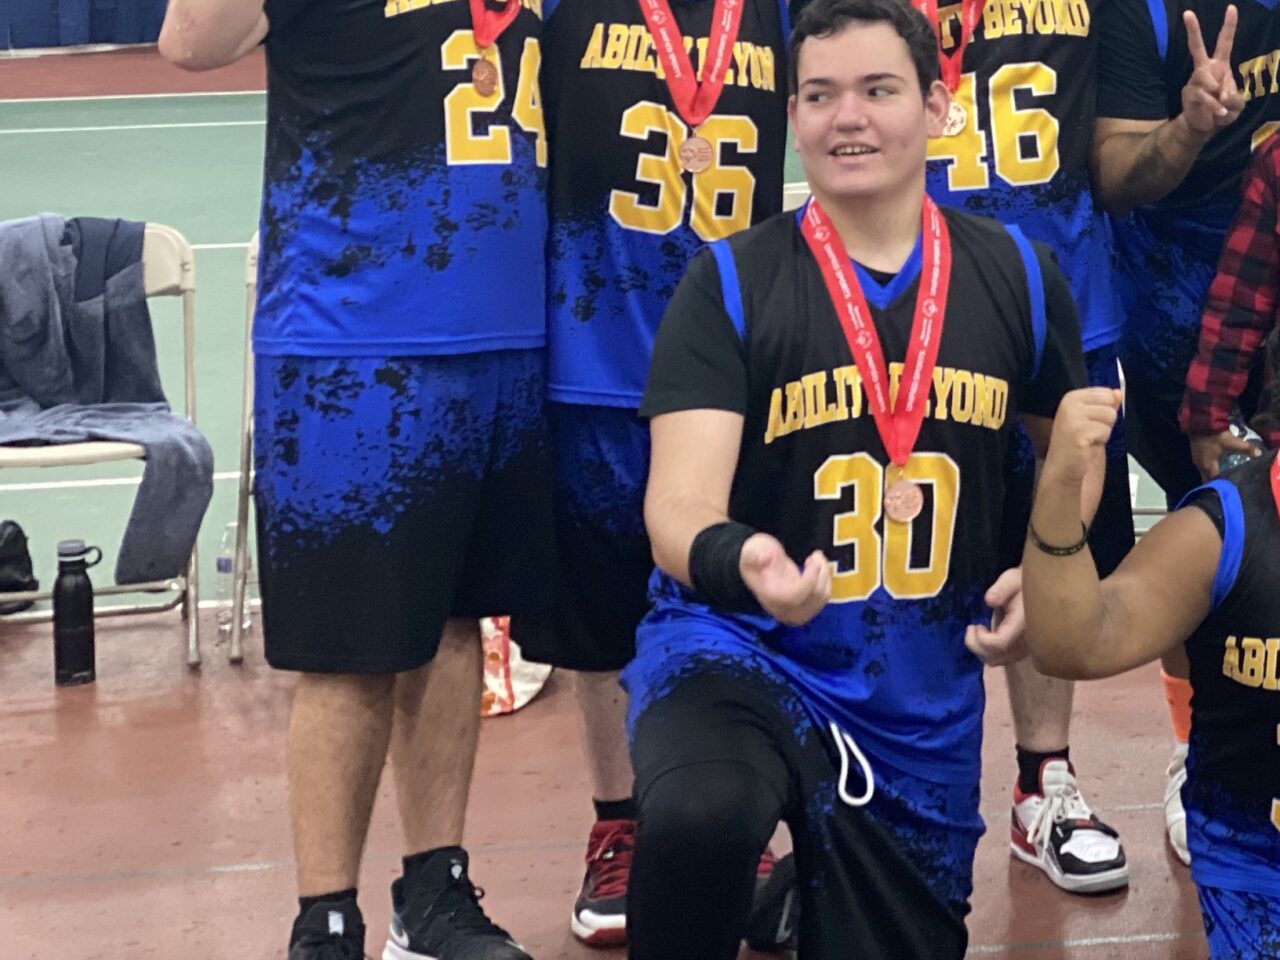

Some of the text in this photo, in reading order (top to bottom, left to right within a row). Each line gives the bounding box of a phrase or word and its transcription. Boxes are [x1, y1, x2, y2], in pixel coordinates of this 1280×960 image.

[441, 29, 548, 168] 24
[580, 22, 693, 80] ABIL
[608, 100, 758, 242] 36
[927, 61, 1060, 192] 46
[764, 365, 873, 444] ABILIT
[814, 451, 960, 603] 30
